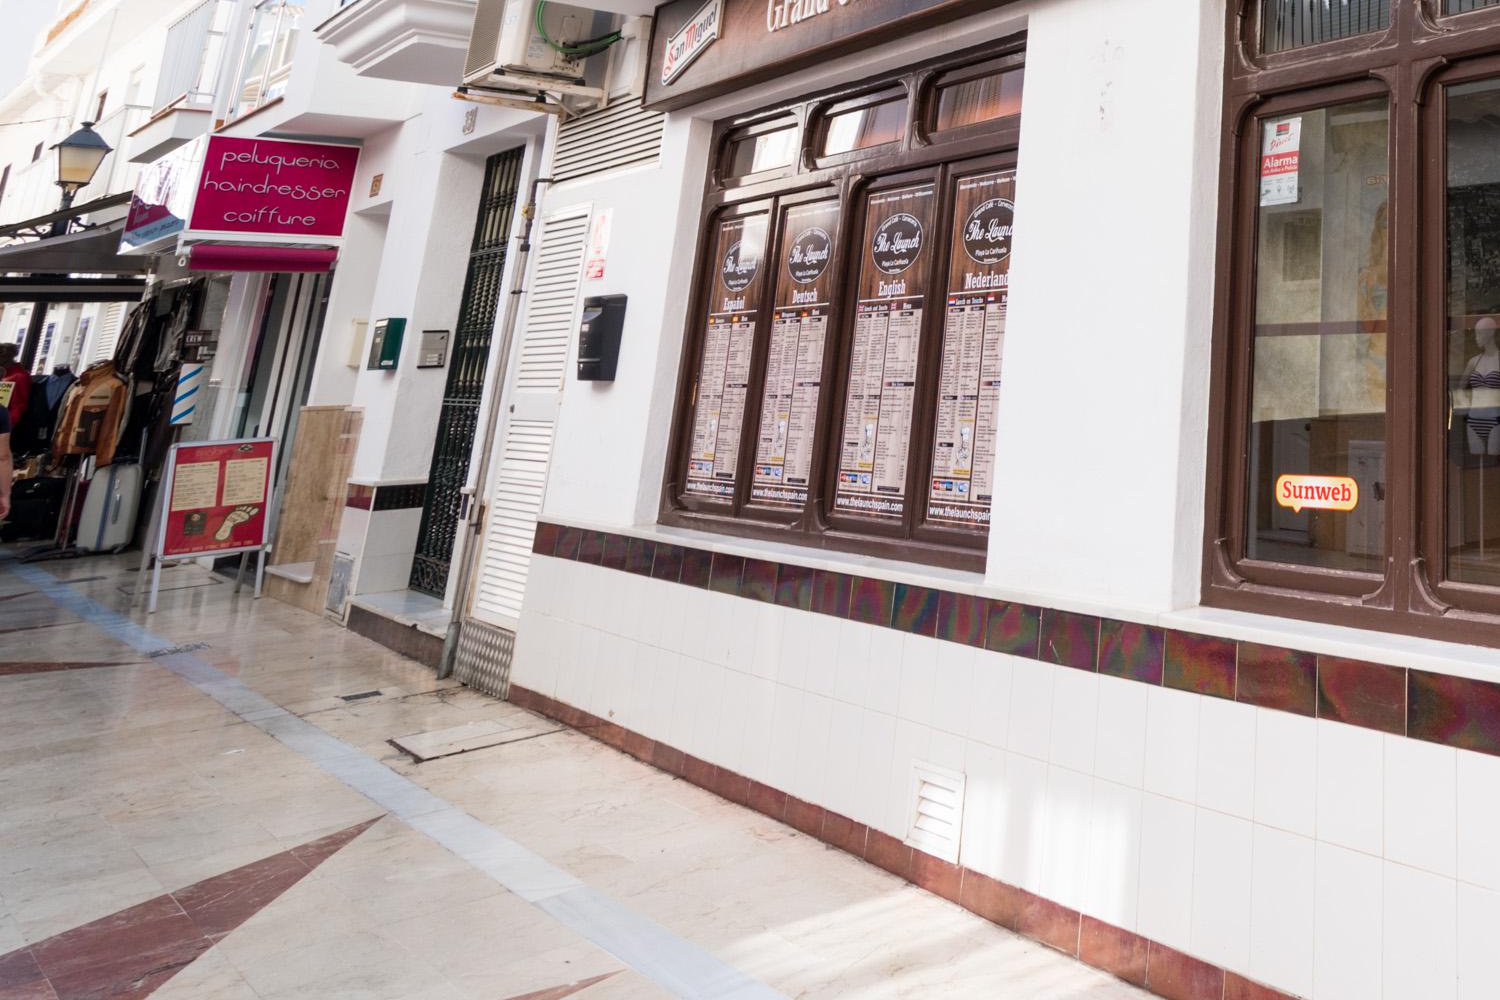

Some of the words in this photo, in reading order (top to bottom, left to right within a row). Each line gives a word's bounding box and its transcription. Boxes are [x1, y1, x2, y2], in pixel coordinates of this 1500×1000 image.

[220, 142, 340, 175] peluqueria
[1264, 156, 1298, 168] Alarma
[203, 170, 346, 201] hairdresser
[223, 206, 317, 226] coiffure
[966, 220, 985, 242] The
[874, 233, 890, 253] The
[890, 230, 921, 255] Launch
[878, 279, 906, 298] English
[1282, 481, 1352, 502] Sunweb
